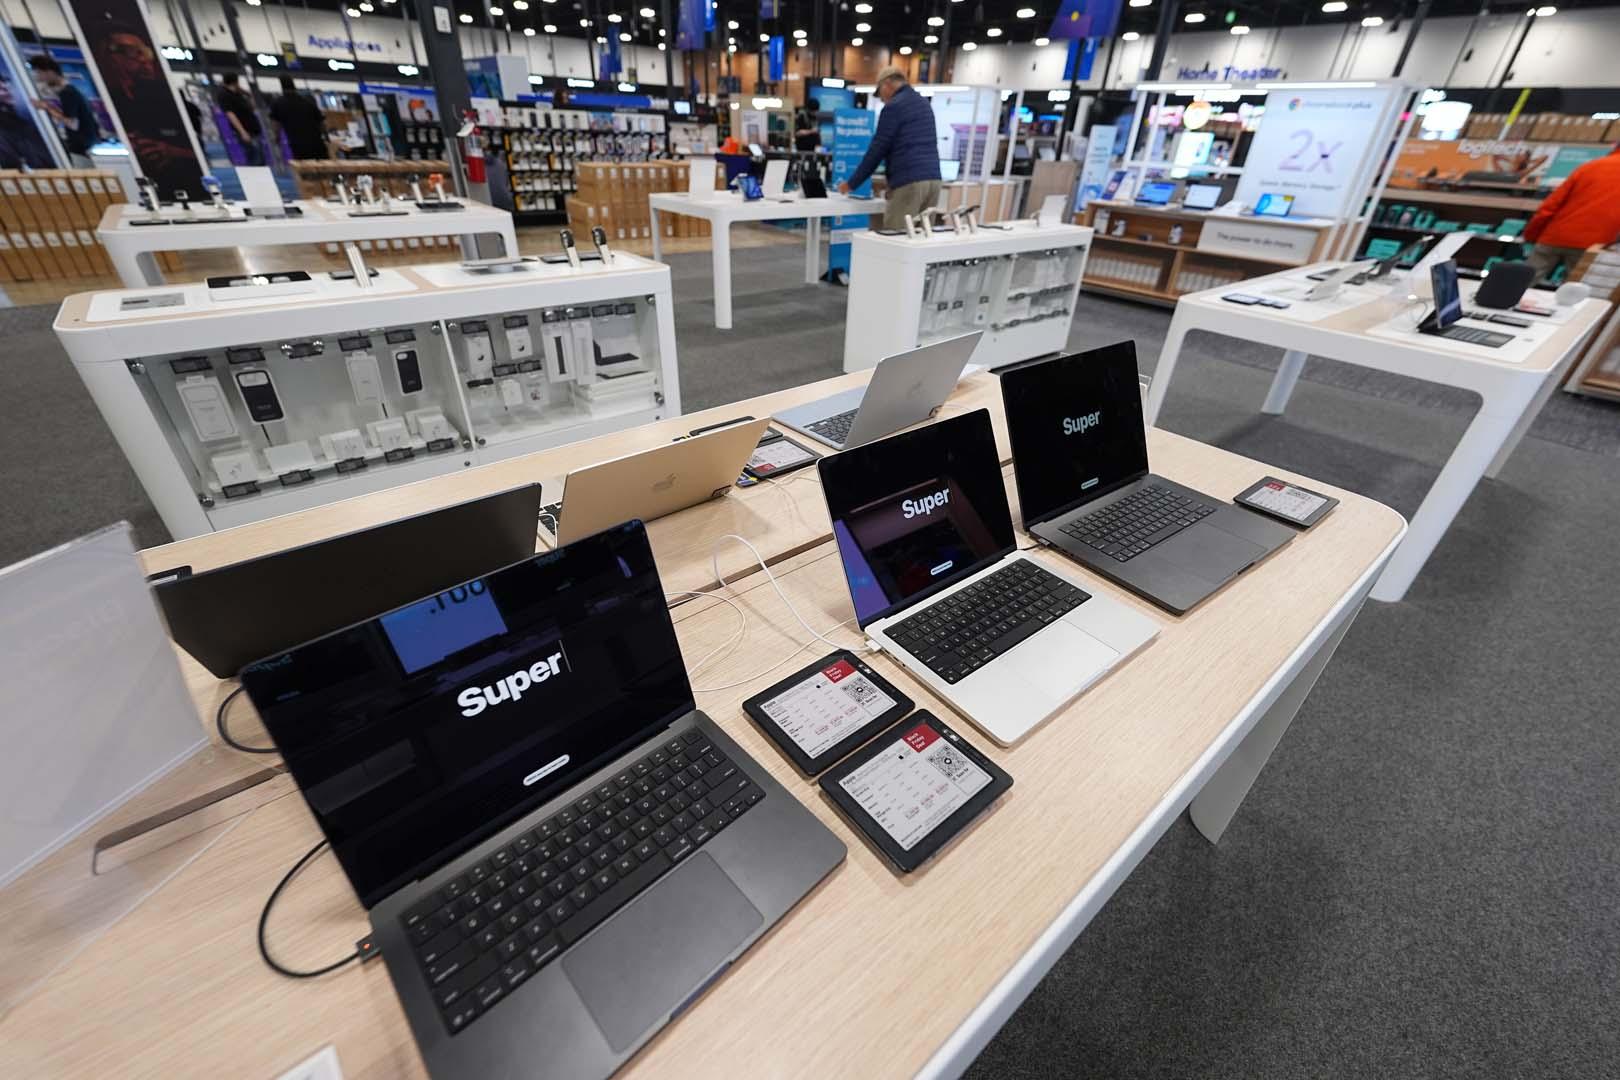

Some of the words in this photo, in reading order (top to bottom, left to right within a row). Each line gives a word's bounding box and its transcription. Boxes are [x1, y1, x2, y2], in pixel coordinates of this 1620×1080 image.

[1178, 66, 1218, 80] Home
[1224, 65, 1281, 81] Theater
[1278, 129, 1343, 174] 2x
[1457, 138, 1527, 159] logitech
[1063, 411, 1101, 435] Super
[901, 488, 951, 519] Super
[457, 652, 562, 718] Super
